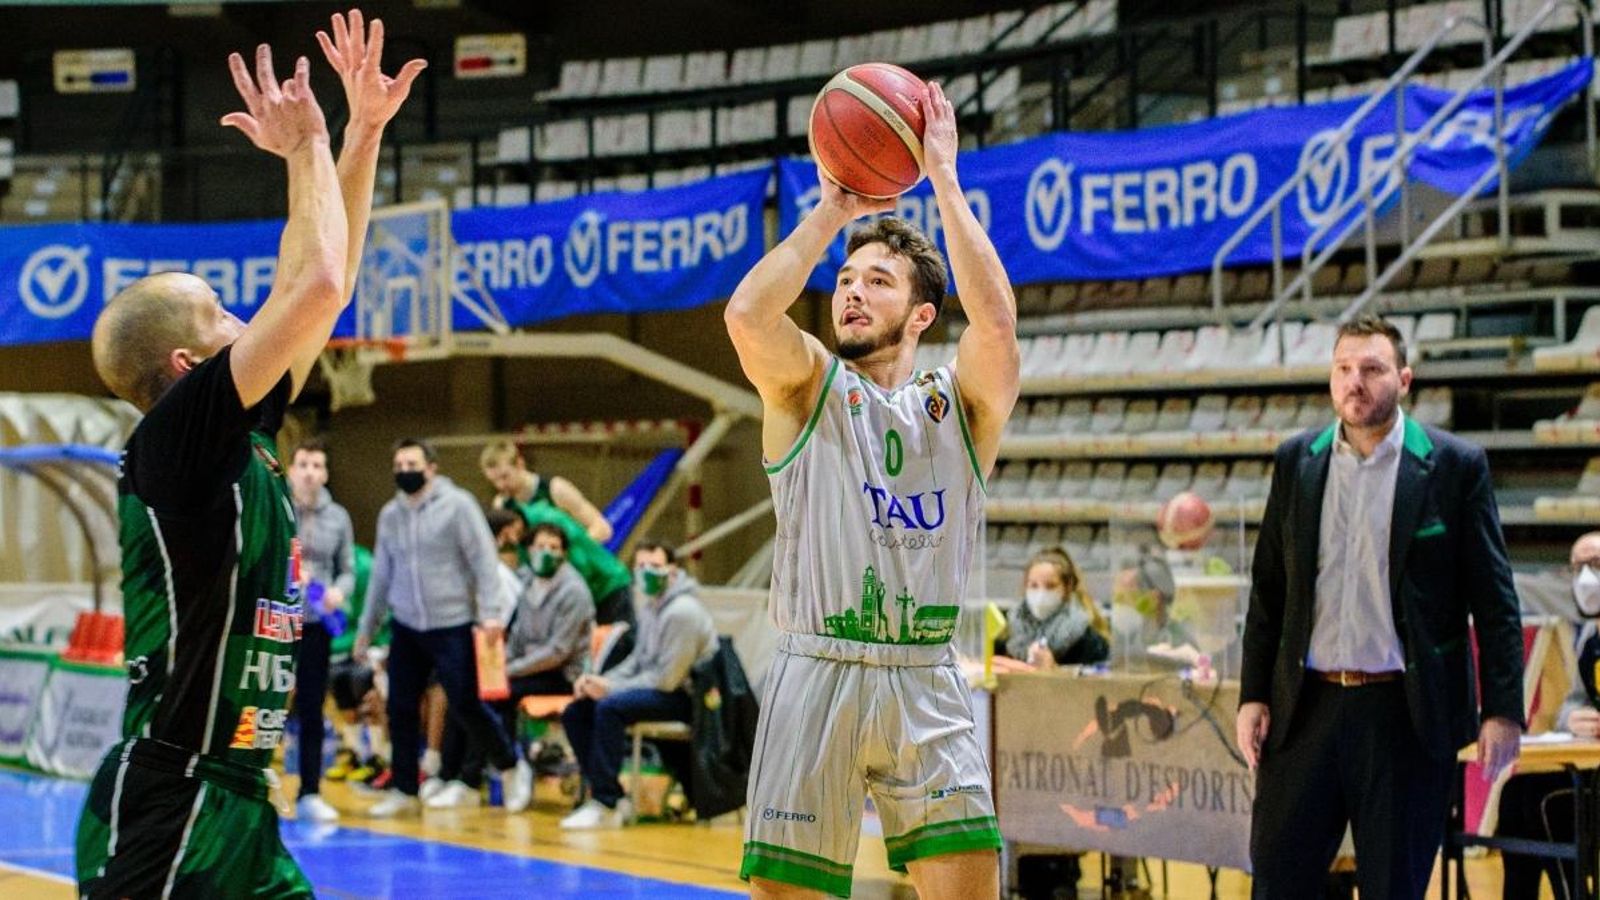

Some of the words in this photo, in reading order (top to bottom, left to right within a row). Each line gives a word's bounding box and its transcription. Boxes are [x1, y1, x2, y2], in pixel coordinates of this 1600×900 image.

[1081, 153, 1258, 235] FERRO
[607, 203, 748, 275] FERRO
[885, 429, 903, 477] 0
[864, 482, 946, 530] TAU
[999, 749, 1114, 797] PATRONAL
[1125, 760, 1251, 815] D'ESPORTS
[776, 811, 816, 823] FERRO
